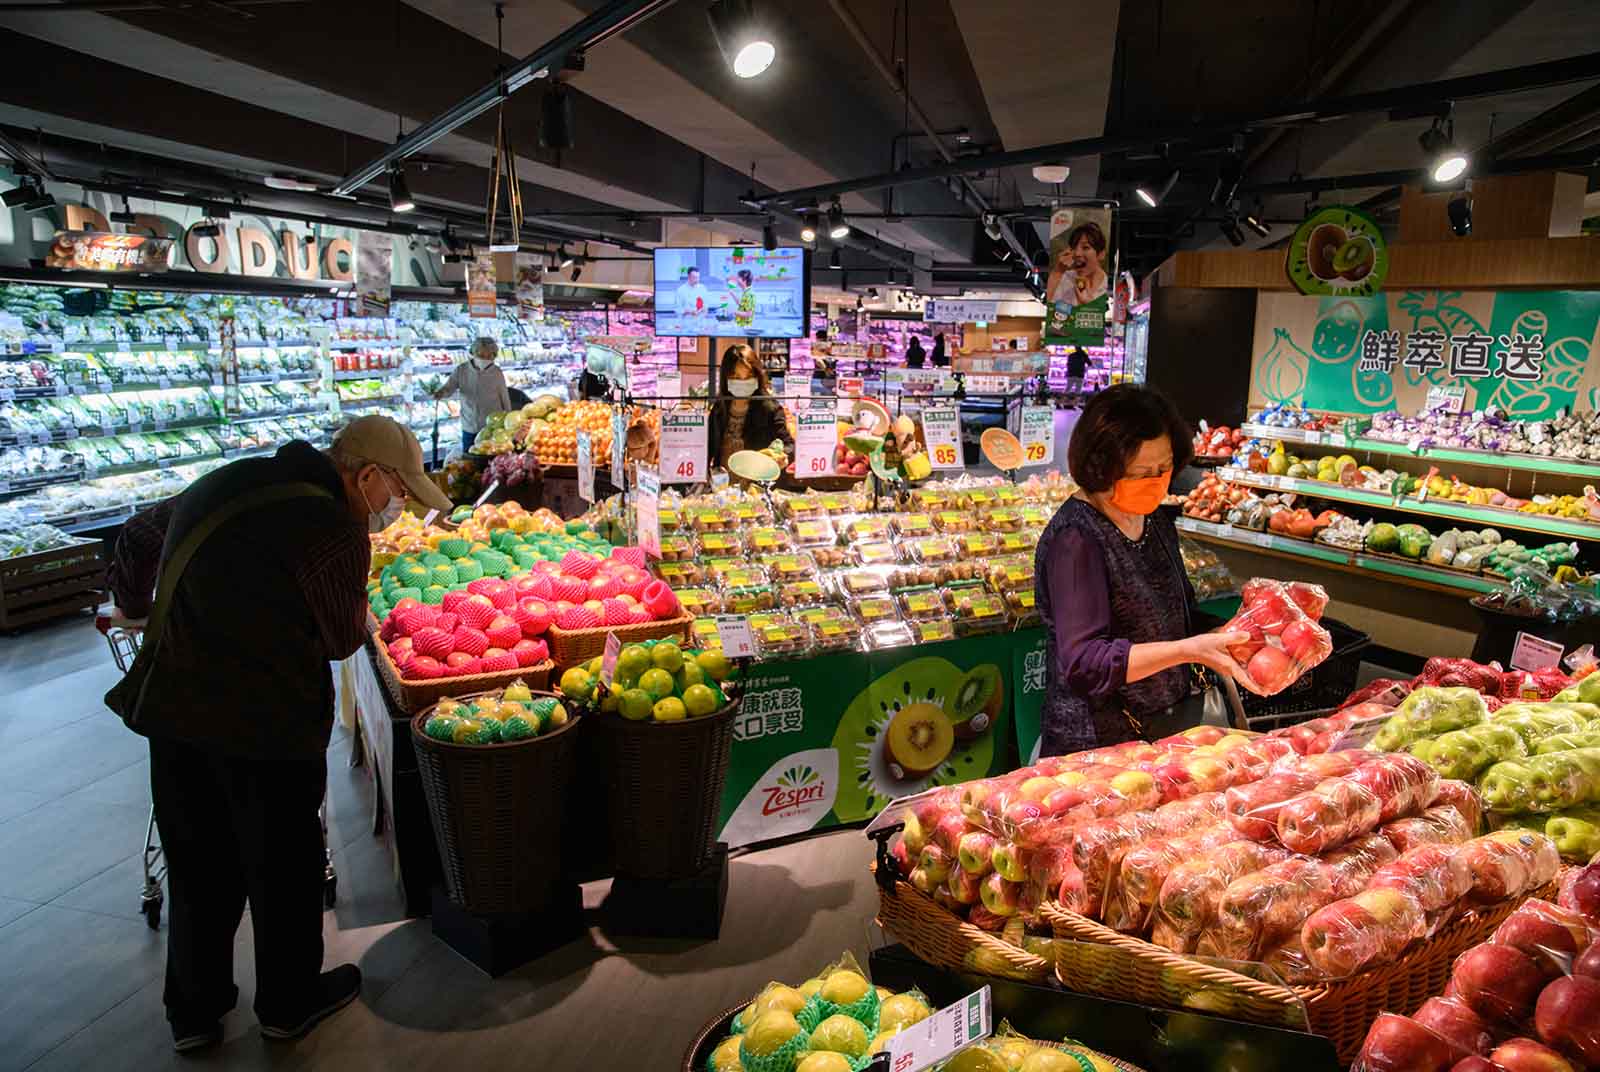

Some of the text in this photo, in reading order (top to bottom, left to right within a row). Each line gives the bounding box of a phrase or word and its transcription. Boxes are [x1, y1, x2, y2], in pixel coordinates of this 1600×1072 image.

[1360, 330, 1546, 380] 鮮萃直送
[935, 448, 956, 464] 85
[1026, 446, 1046, 461] 79
[677, 462, 694, 476] 48
[811, 457, 826, 471] 60
[738, 688, 802, 716] 康就該
[762, 780, 825, 817] Zespri
